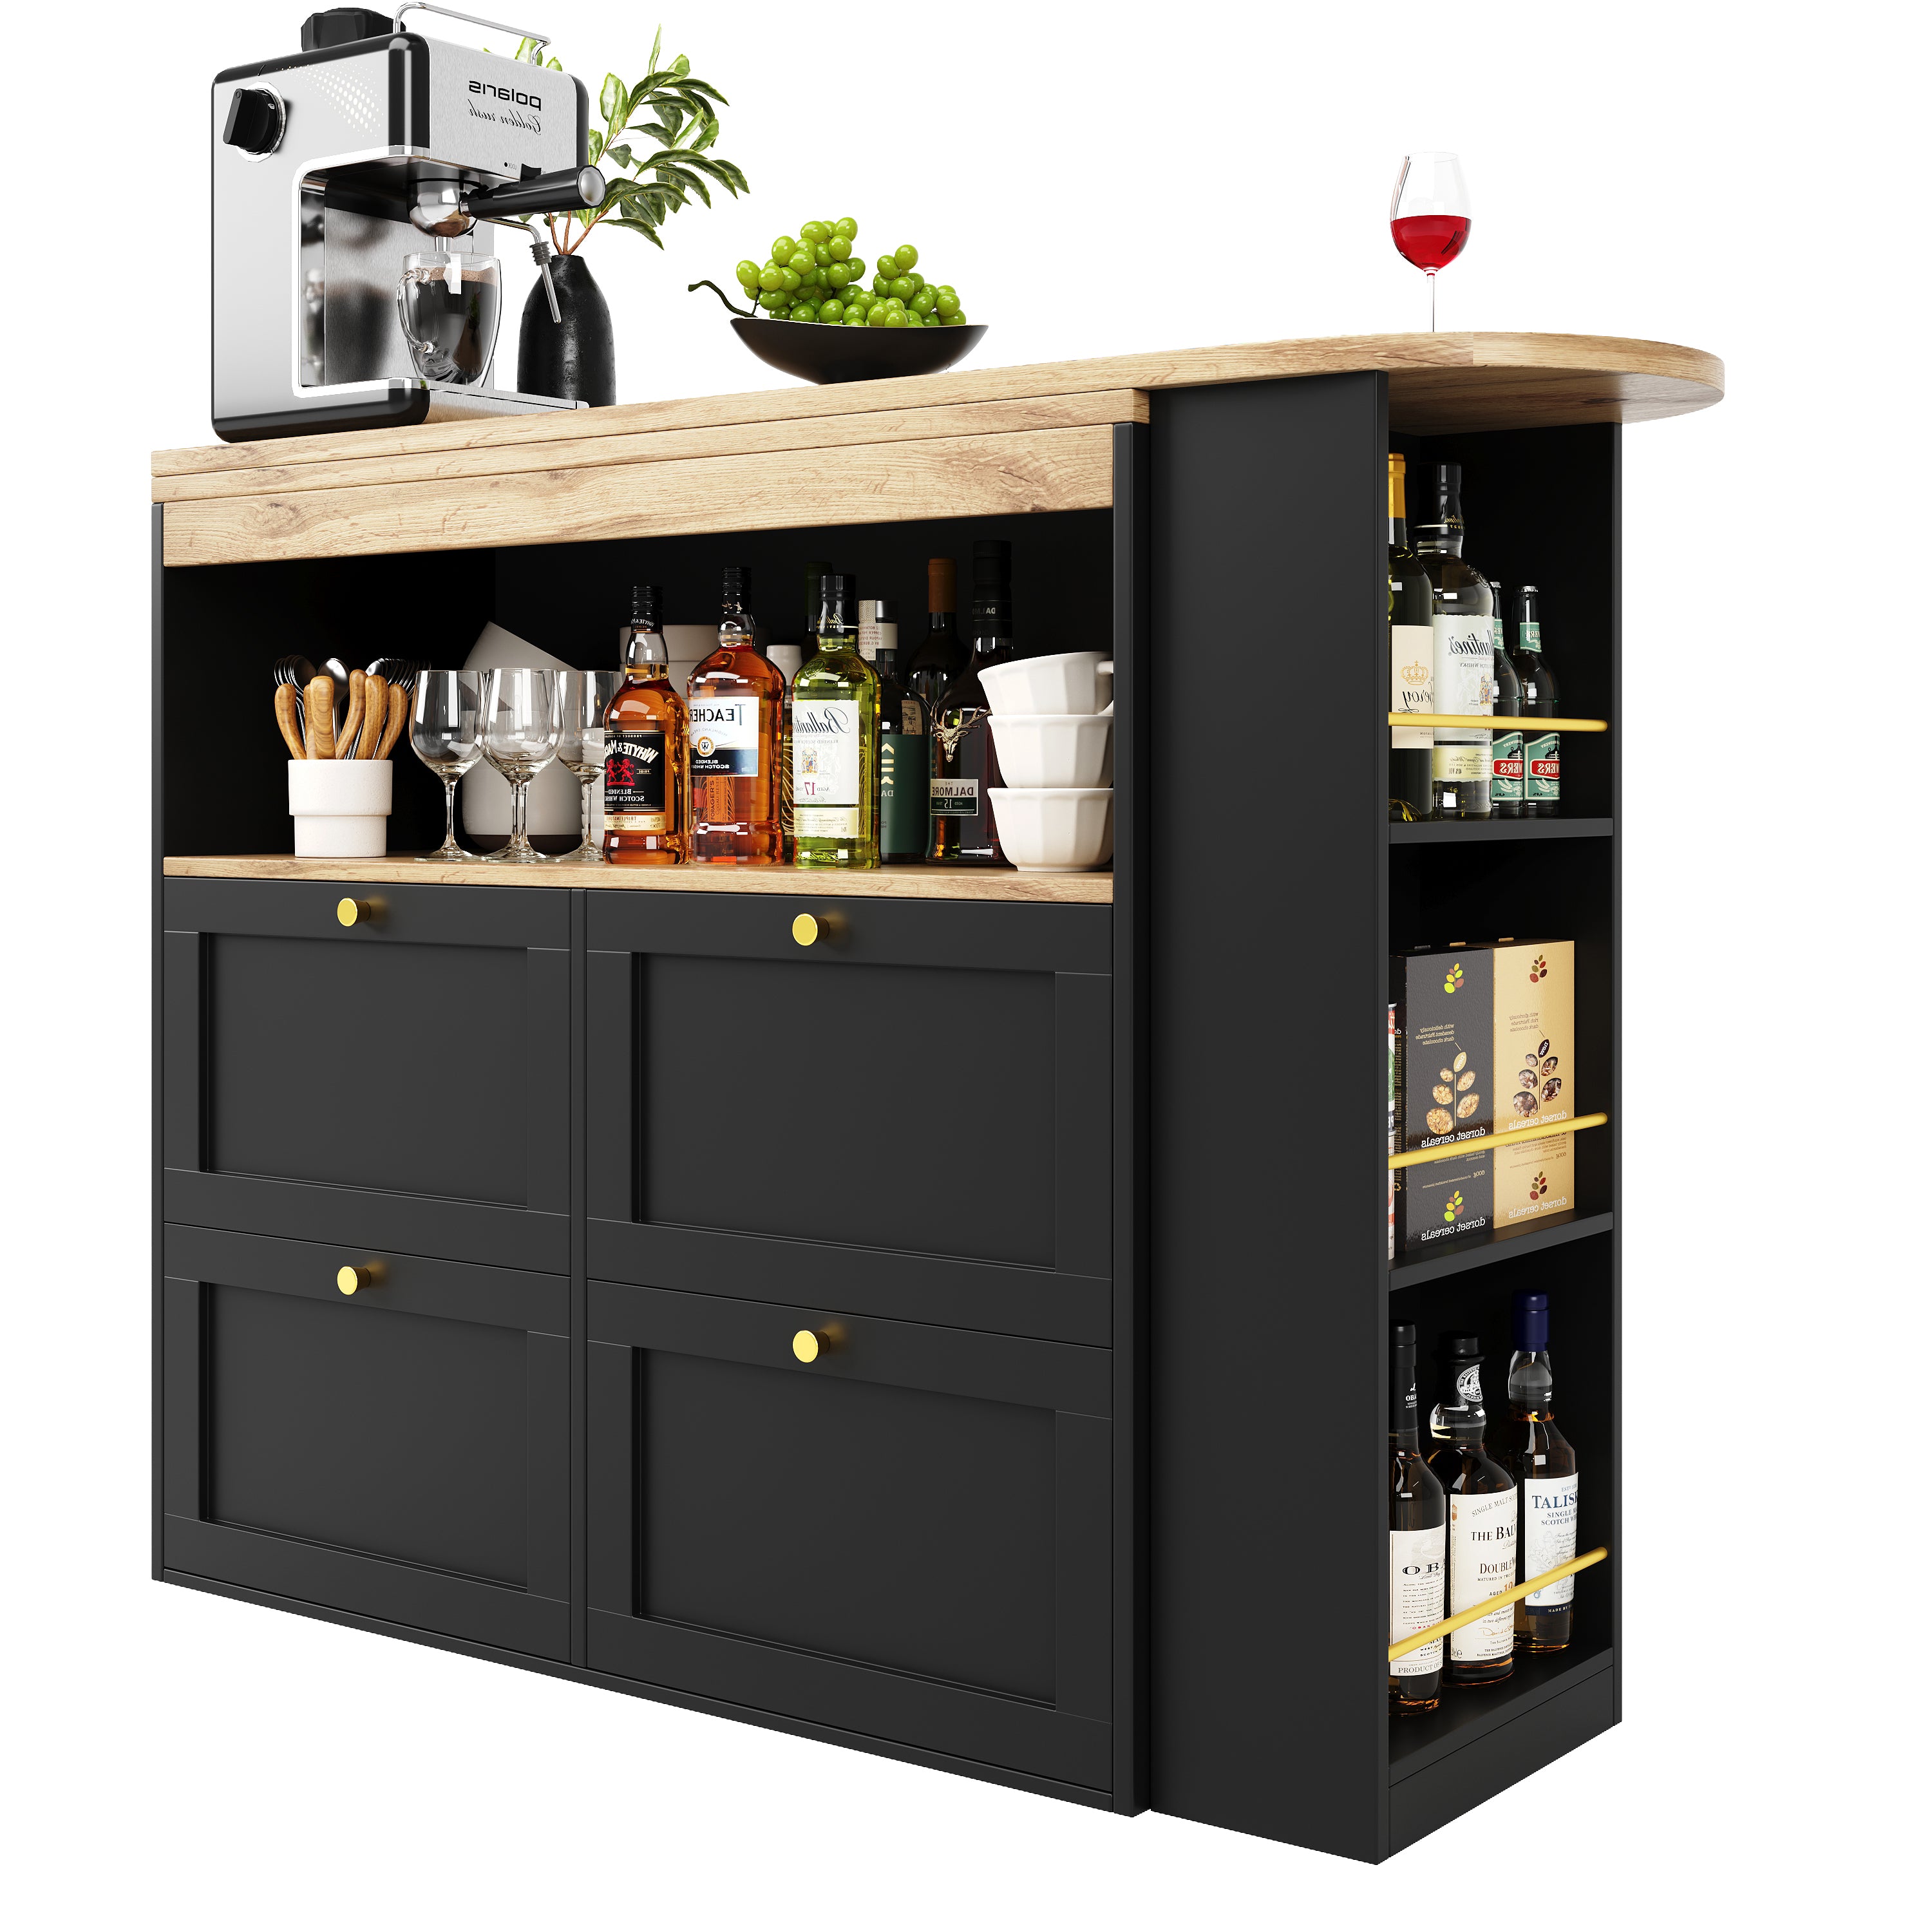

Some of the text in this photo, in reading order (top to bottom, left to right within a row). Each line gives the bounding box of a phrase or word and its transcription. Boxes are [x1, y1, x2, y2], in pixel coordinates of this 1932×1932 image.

[1472, 1497, 1508, 1517] SINGLE MALT
[1547, 1509, 1572, 1518] SINGLE
[1541, 1517, 1569, 1526] SCOTCH
[1470, 1531, 1493, 1541] THE
[1397, 1664, 1434, 1674] PRODUCT
